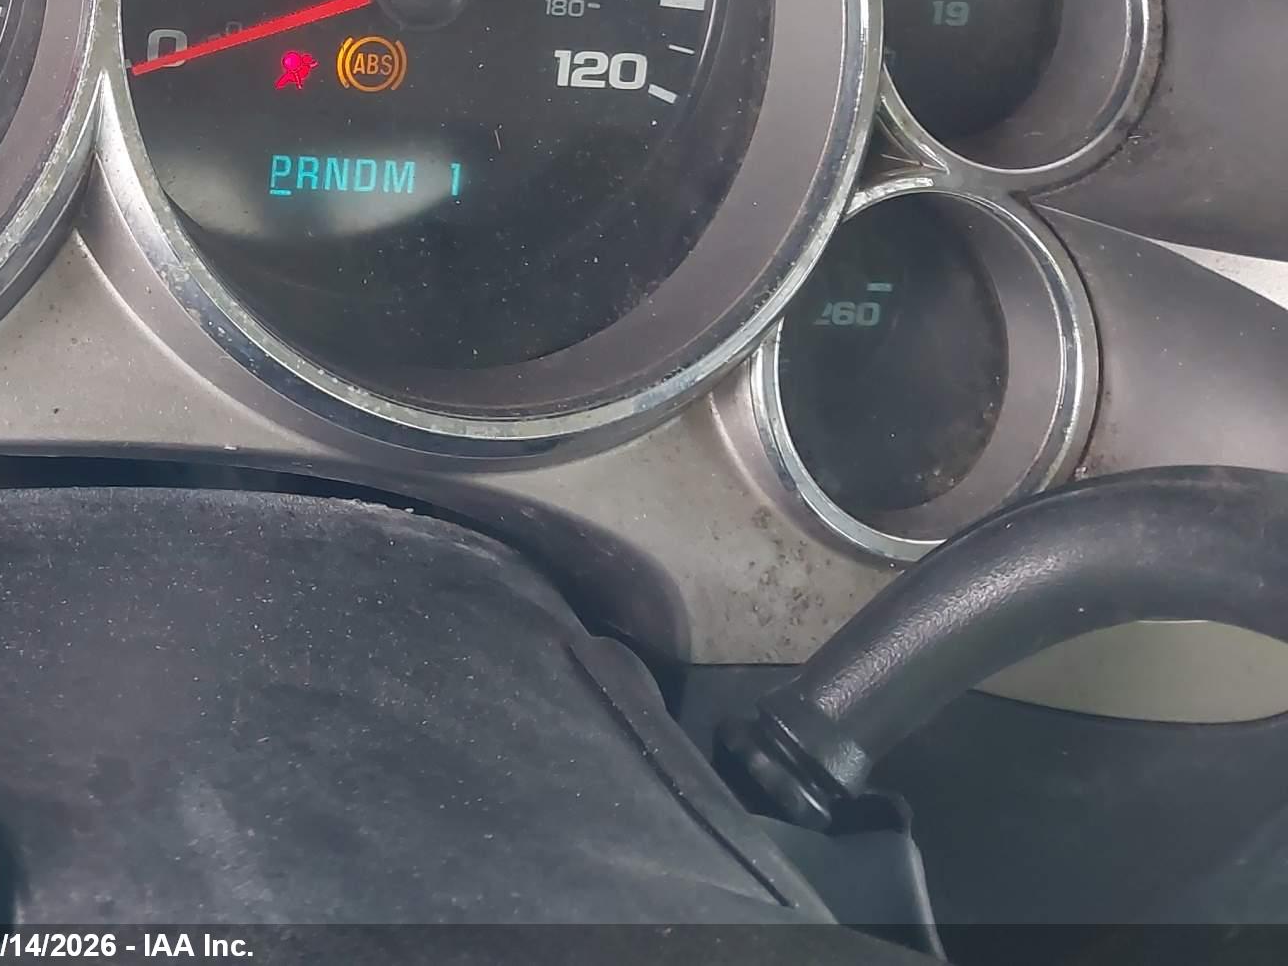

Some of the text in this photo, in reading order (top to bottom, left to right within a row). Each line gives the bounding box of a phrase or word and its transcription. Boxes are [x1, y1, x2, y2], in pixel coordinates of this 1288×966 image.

[932, 0, 970, 26] 19
[147, 29, 187, 67] 0
[352, 52, 393, 77] ABS
[554, 49, 648, 90] 120
